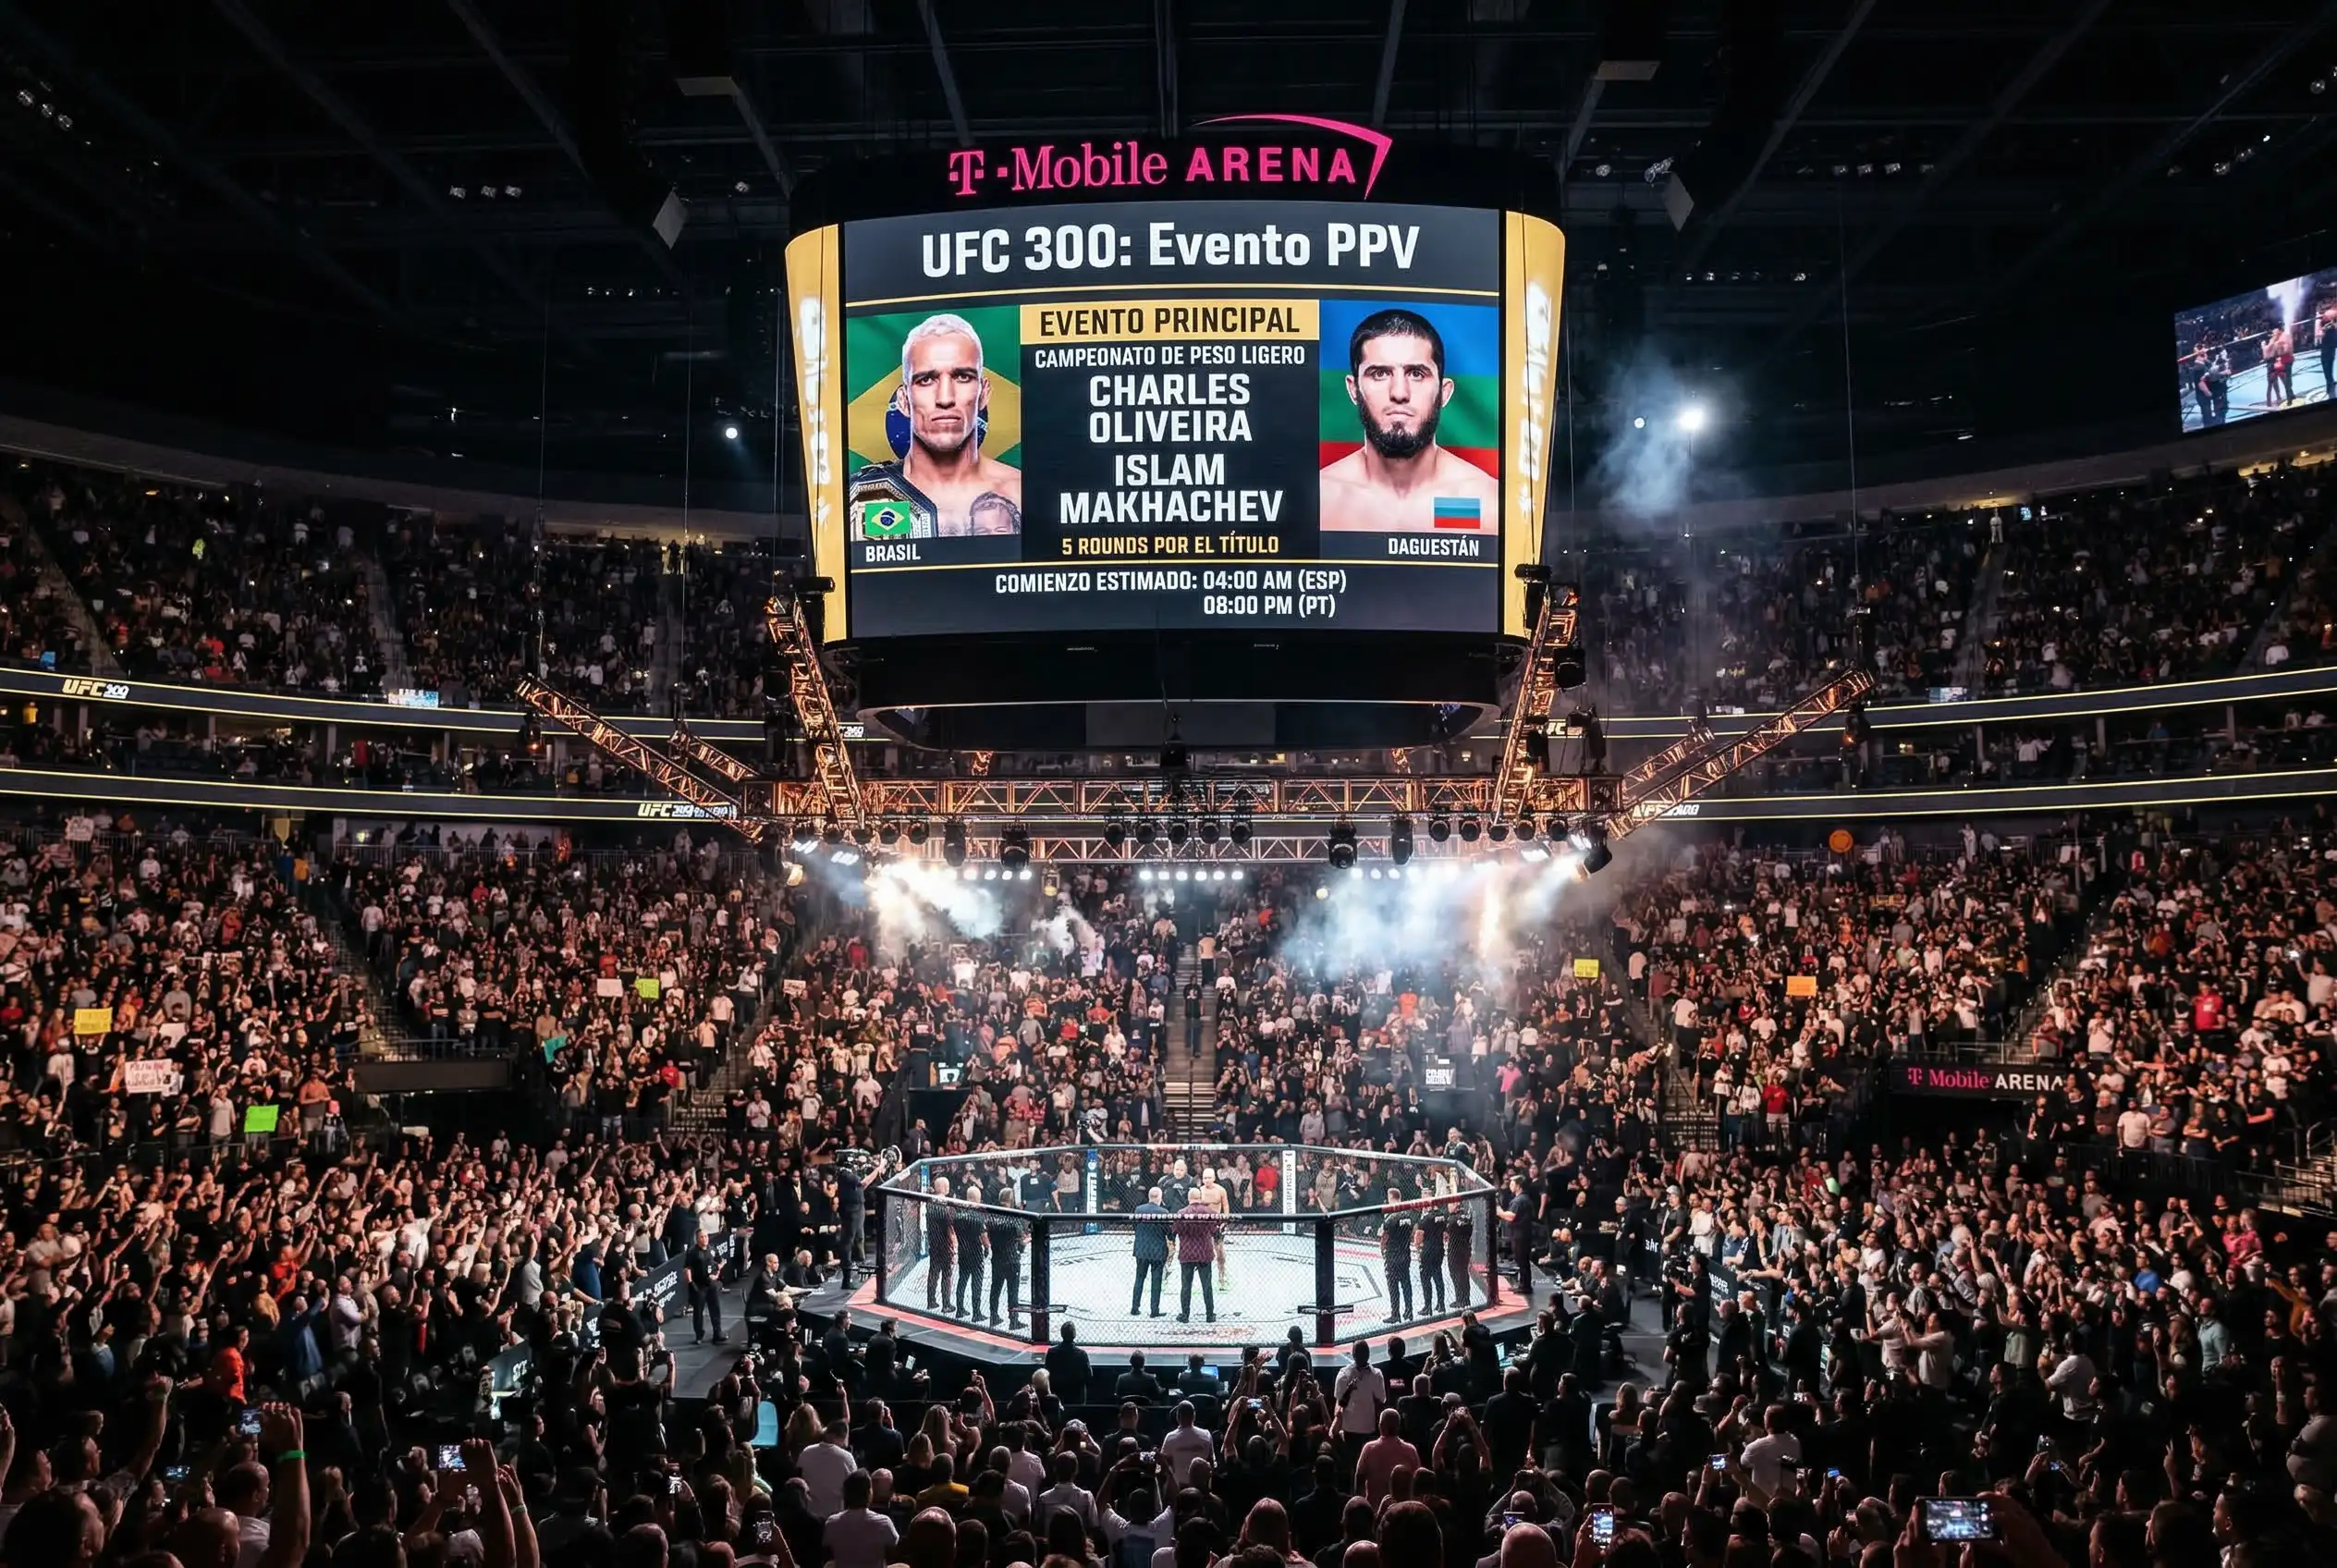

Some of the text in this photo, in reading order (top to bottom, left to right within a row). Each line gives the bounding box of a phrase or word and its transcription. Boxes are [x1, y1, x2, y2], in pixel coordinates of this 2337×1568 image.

[1185, 146, 1357, 185] ARENA
[924, 221, 1421, 278] UFC 300: Evento PPV
[1040, 307, 1300, 337] EVENTO PRINCIPAL
[1034, 345, 1305, 369] CAMPEONATO DE PESO LIGERO
[1089, 373, 1251, 407] CHARLES
[1089, 410, 1253, 444] OLIVEIRA
[1115, 453, 1225, 486] ISLAM
[1059, 489, 1284, 524] MAKHACHEV
[865, 543, 922, 563] BRASIL
[1062, 530, 1279, 556] 5 ROUNDS POR EL TÍTULO
[1388, 534, 1480, 557] DAGUESTÁN
[996, 569, 1347, 594] COMIENZO ESTIMADO: 04:00 AM (ESP)
[1204, 594, 1336, 619] 08:00 PM (PT)
[62, 679, 106, 697] UFC
[637, 803, 672, 817] UFC
